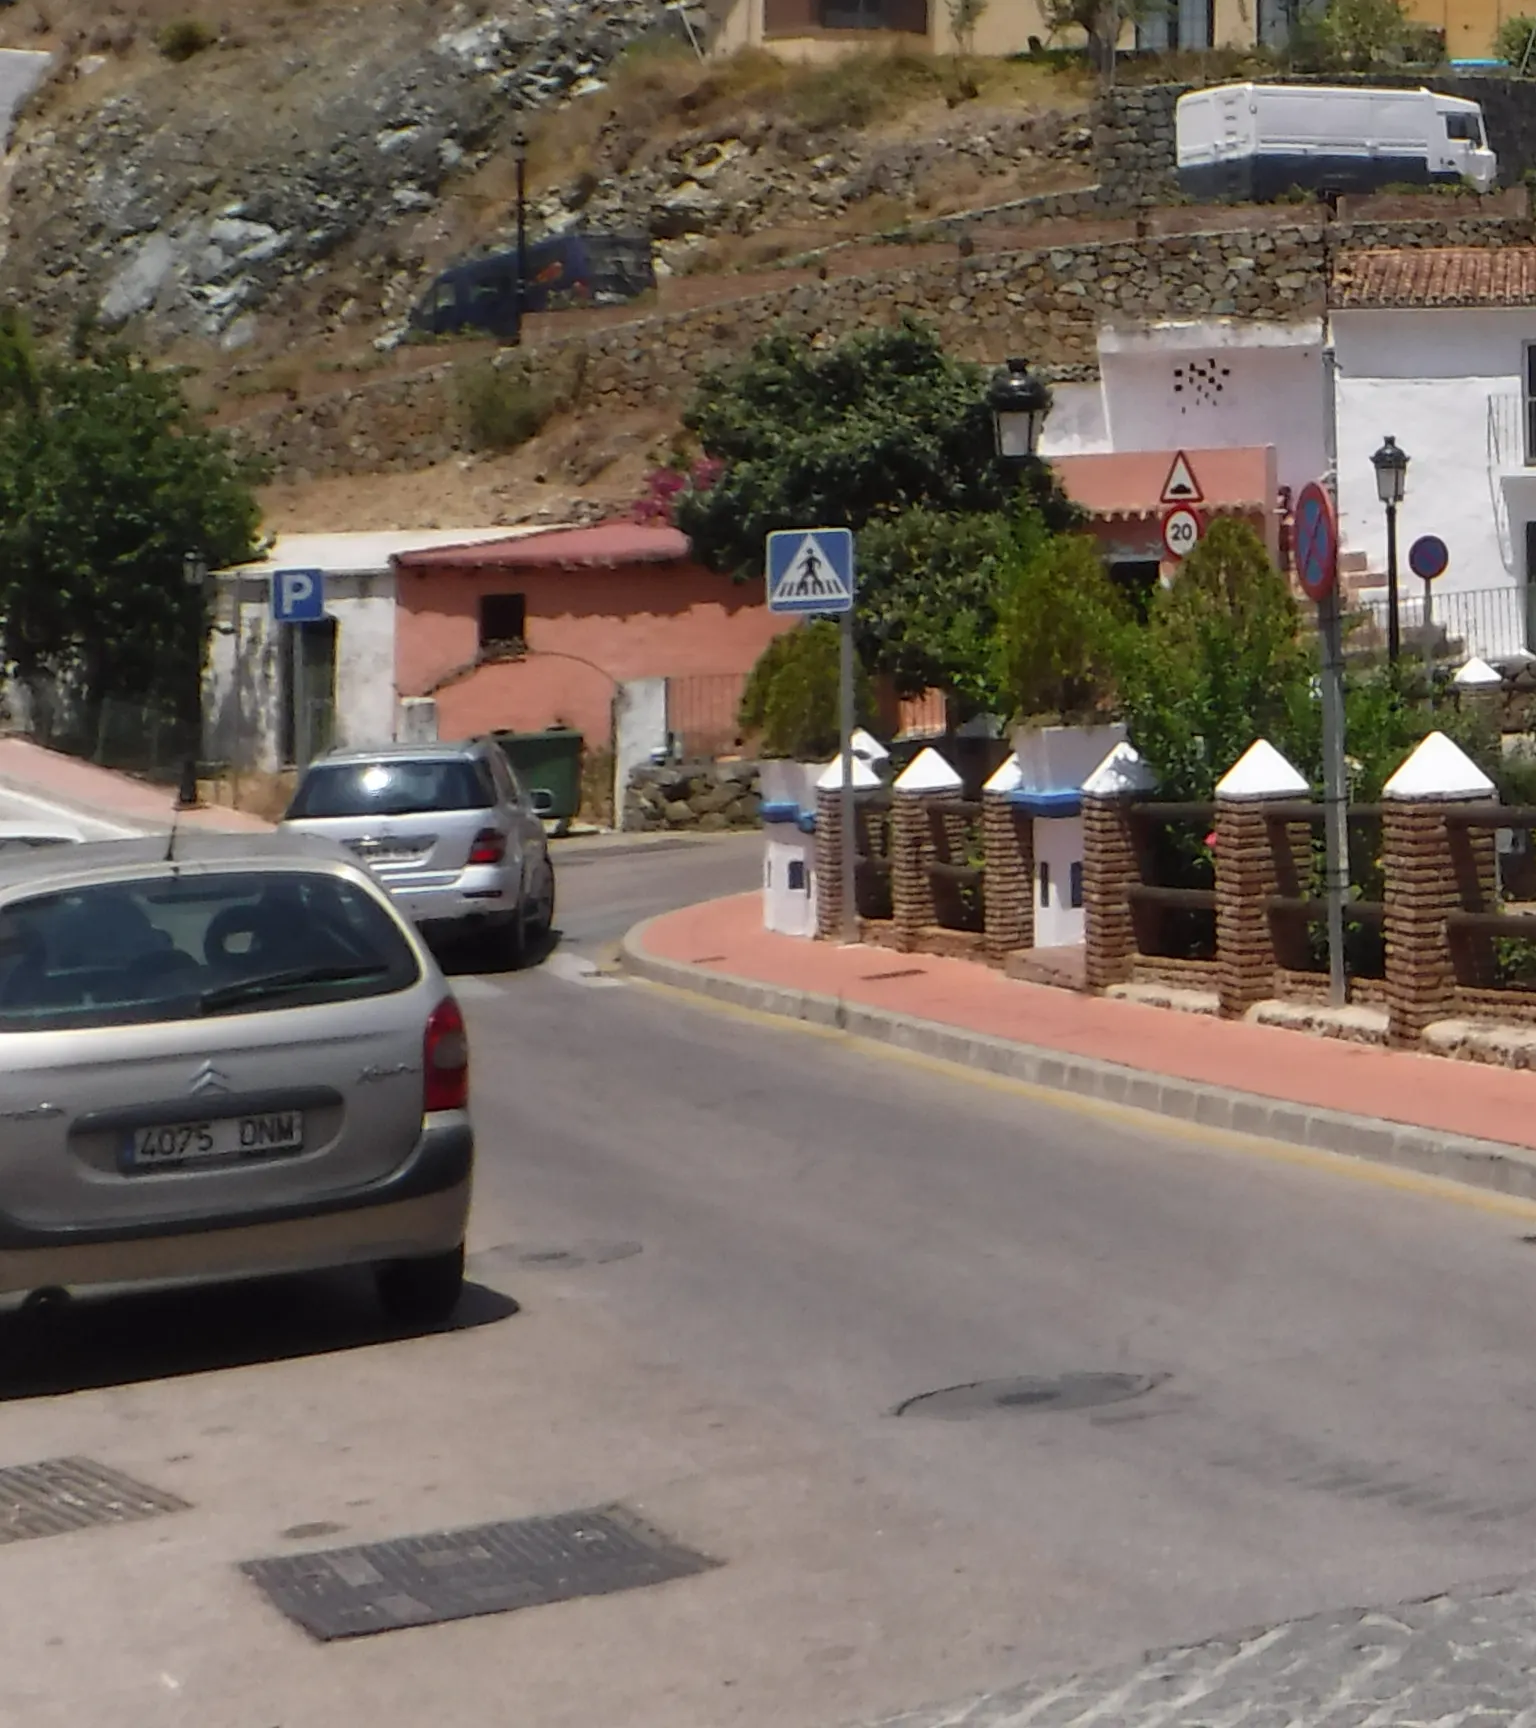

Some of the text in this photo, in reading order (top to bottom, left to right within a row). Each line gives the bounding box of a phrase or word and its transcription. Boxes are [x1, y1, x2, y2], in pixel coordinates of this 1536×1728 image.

[1171, 522, 1192, 541] 20
[282, 573, 313, 614] P
[141, 1123, 213, 1156] 4075
